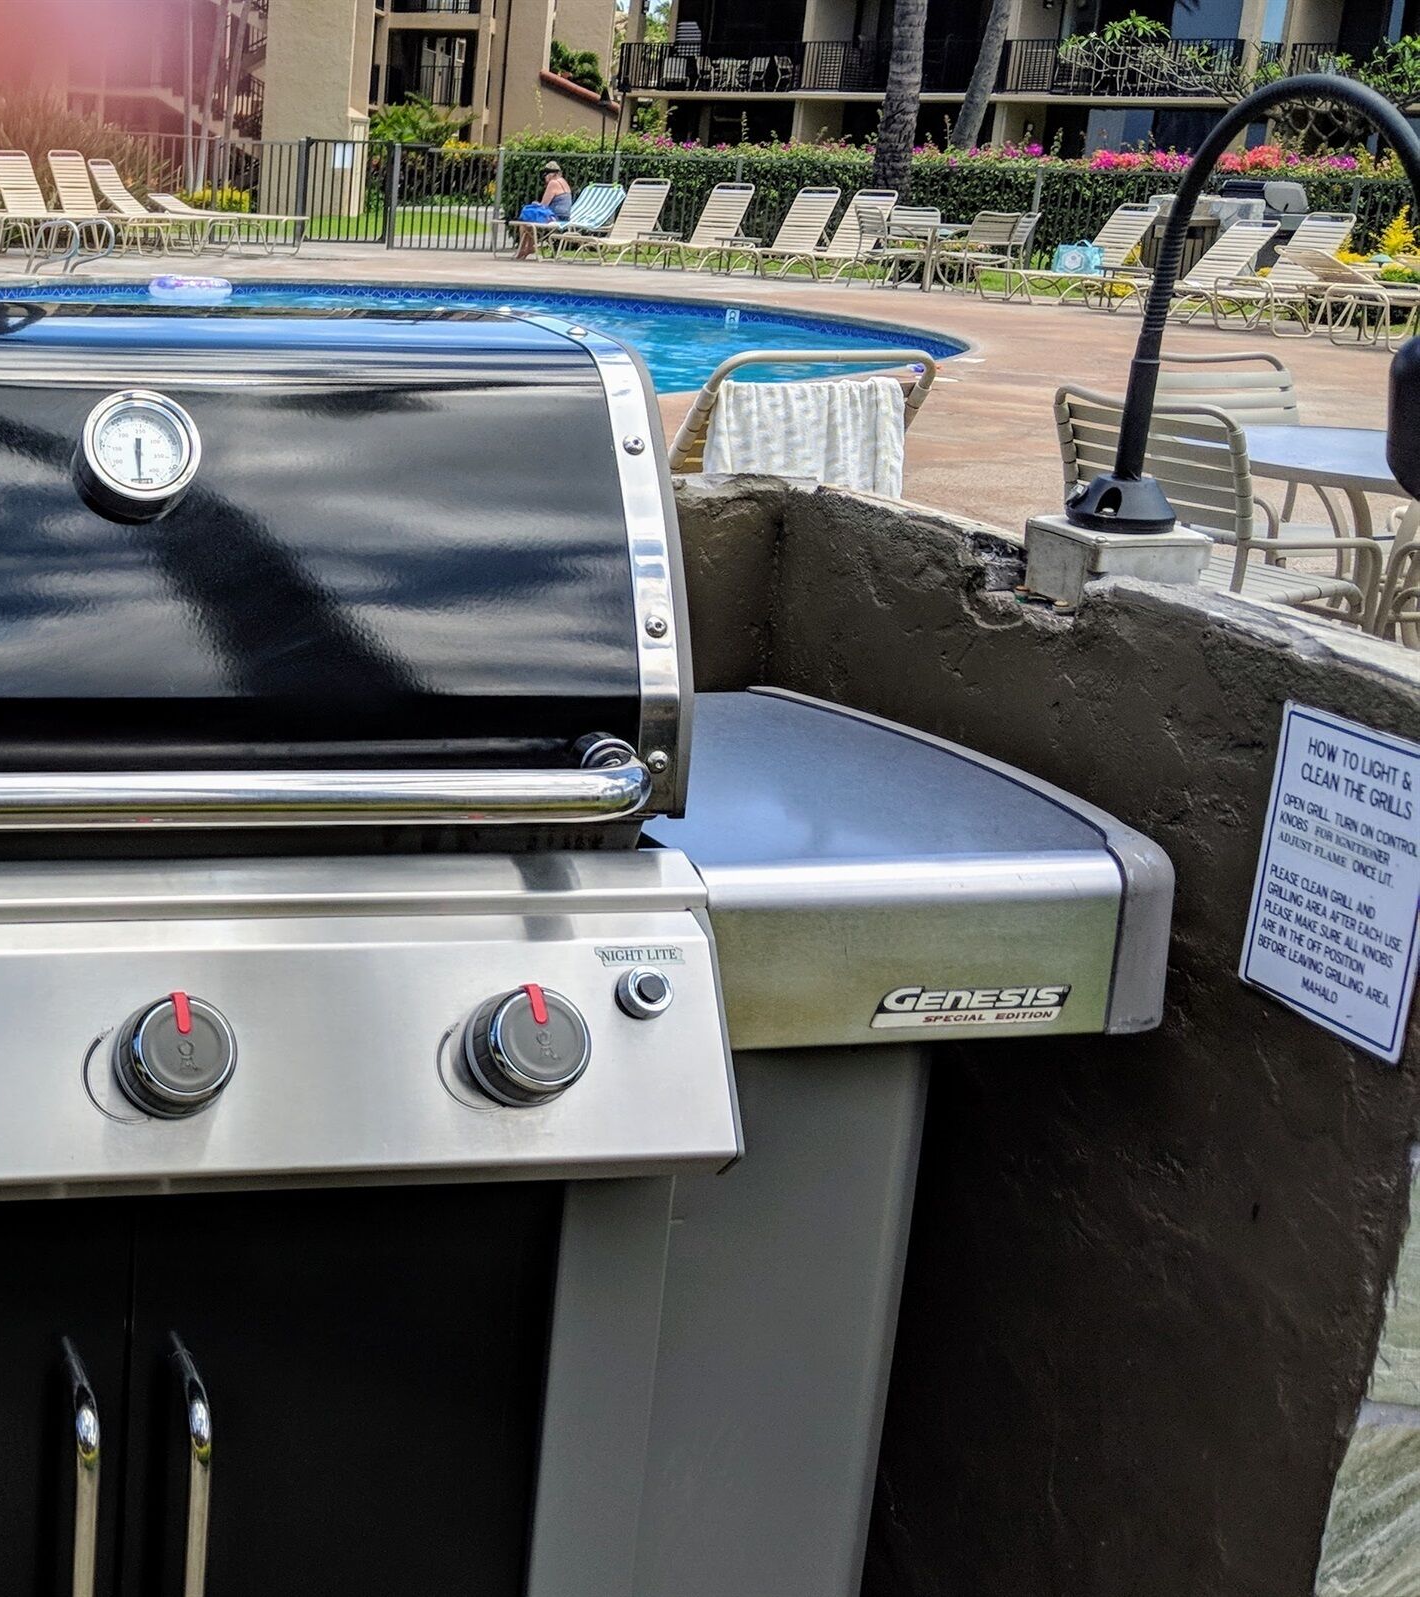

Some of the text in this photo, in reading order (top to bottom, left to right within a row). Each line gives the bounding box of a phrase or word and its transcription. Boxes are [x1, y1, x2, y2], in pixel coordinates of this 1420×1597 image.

[1301, 762, 1413, 820] CLEAN THE GRILLS
[1308, 737, 1412, 791] HOW TO LIGHT &
[1279, 810, 1309, 832] KNOBS
[1314, 825, 1333, 843] FOR
[1283, 793, 1305, 812] OPEN
[1335, 812, 1358, 834] TURN
[1360, 823, 1375, 840] ON
[1376, 829, 1418, 857] CONTROL
[1278, 831, 1313, 853] ADJUST
[1314, 844, 1347, 867] FLAME
[1352, 859, 1376, 881] ONCE
[1267, 881, 1303, 908] GRILLING
[1305, 899, 1327, 919] AREA
[1329, 910, 1357, 932] AFTER
[1357, 921, 1382, 943] EACH
[1270, 863, 1376, 919] PLEASE CLEAN GRILL AND
[600, 949, 677, 962] NIGHT LITE
[1260, 917, 1366, 975] ARE IN THE OFF POSITION
[1264, 899, 1394, 969] PLEASE MAKE SURE ALL KNOBS
[1258, 934, 1287, 959] BEFORE
[1288, 948, 1323, 975] LEAVING
[1325, 965, 1364, 995] GRILLING
[1301, 976, 1338, 1005] MAHALO
[883, 986, 1066, 1012] GENESIS
[922, 1010, 1054, 1023] SPECIAL EDITION
